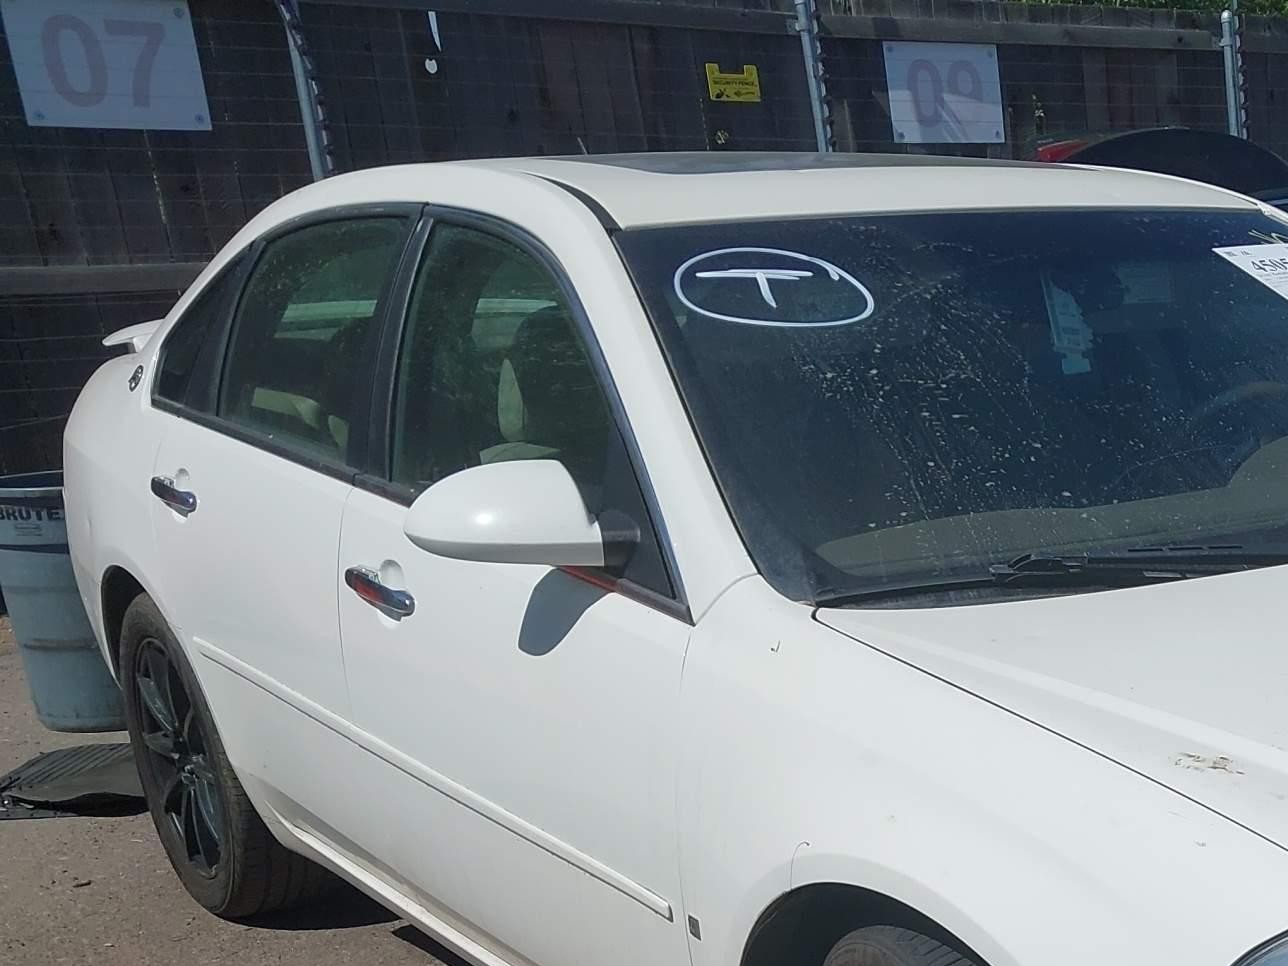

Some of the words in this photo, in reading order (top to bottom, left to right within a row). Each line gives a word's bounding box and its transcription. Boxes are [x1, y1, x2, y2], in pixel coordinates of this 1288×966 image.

[42, 14, 166, 108] 07
[907, 58, 985, 128] 09
[695, 269, 813, 308] T
